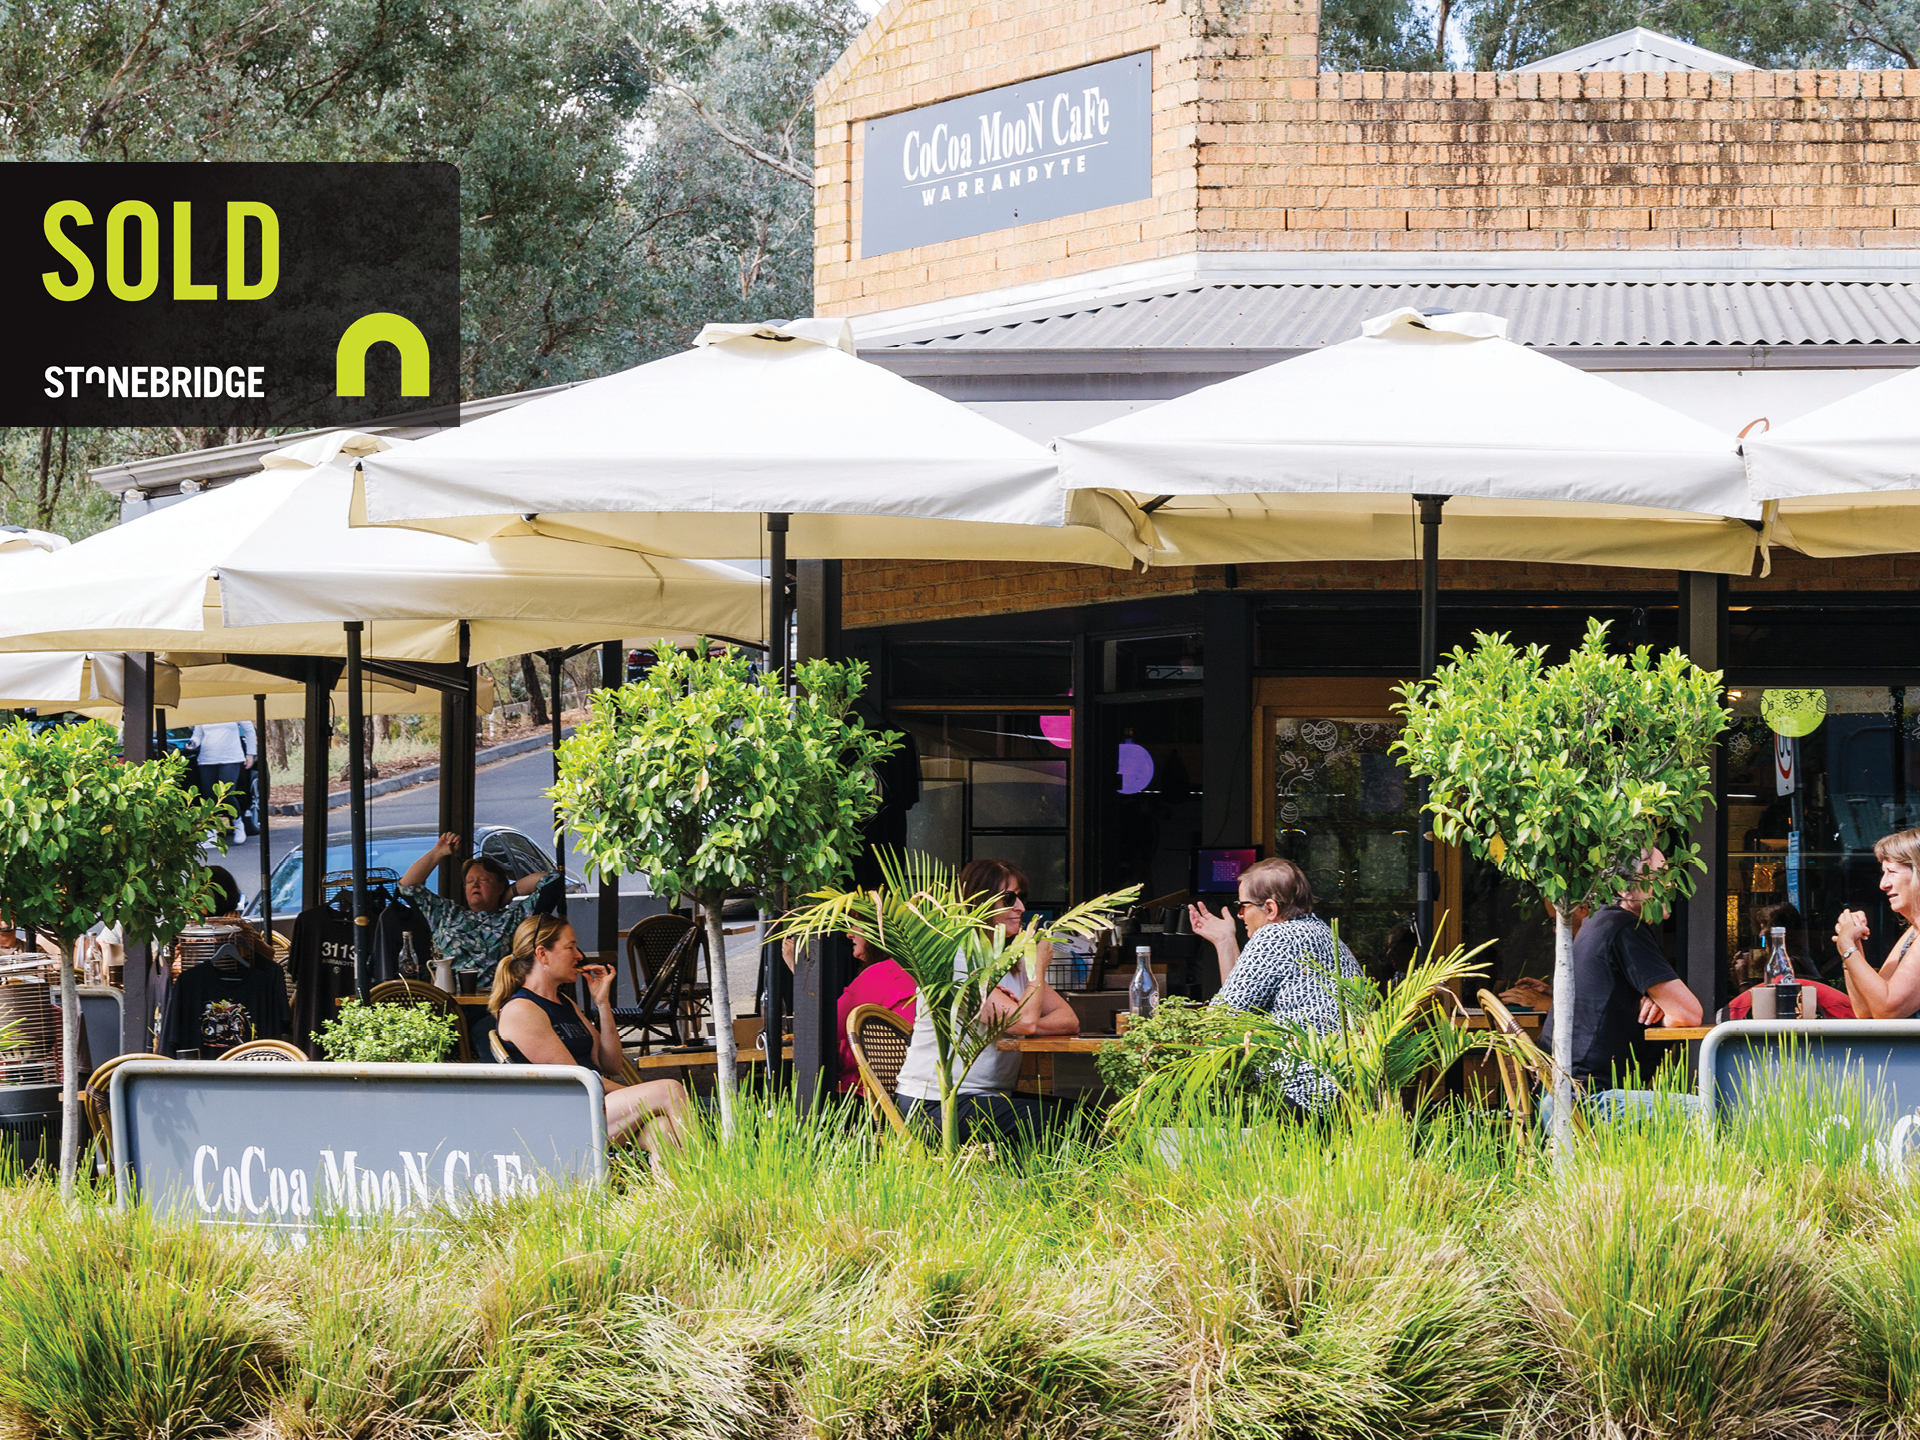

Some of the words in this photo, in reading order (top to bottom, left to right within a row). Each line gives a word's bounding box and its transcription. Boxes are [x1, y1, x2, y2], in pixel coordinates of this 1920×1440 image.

[903, 123, 972, 181] CoCoa
[979, 100, 1045, 166] MooN
[1052, 87, 1110, 147] CaFe
[922, 155, 1087, 206] WARRANDYTE
[321, 941, 357, 960] 3113
[193, 1145, 311, 1216] CoCoa
